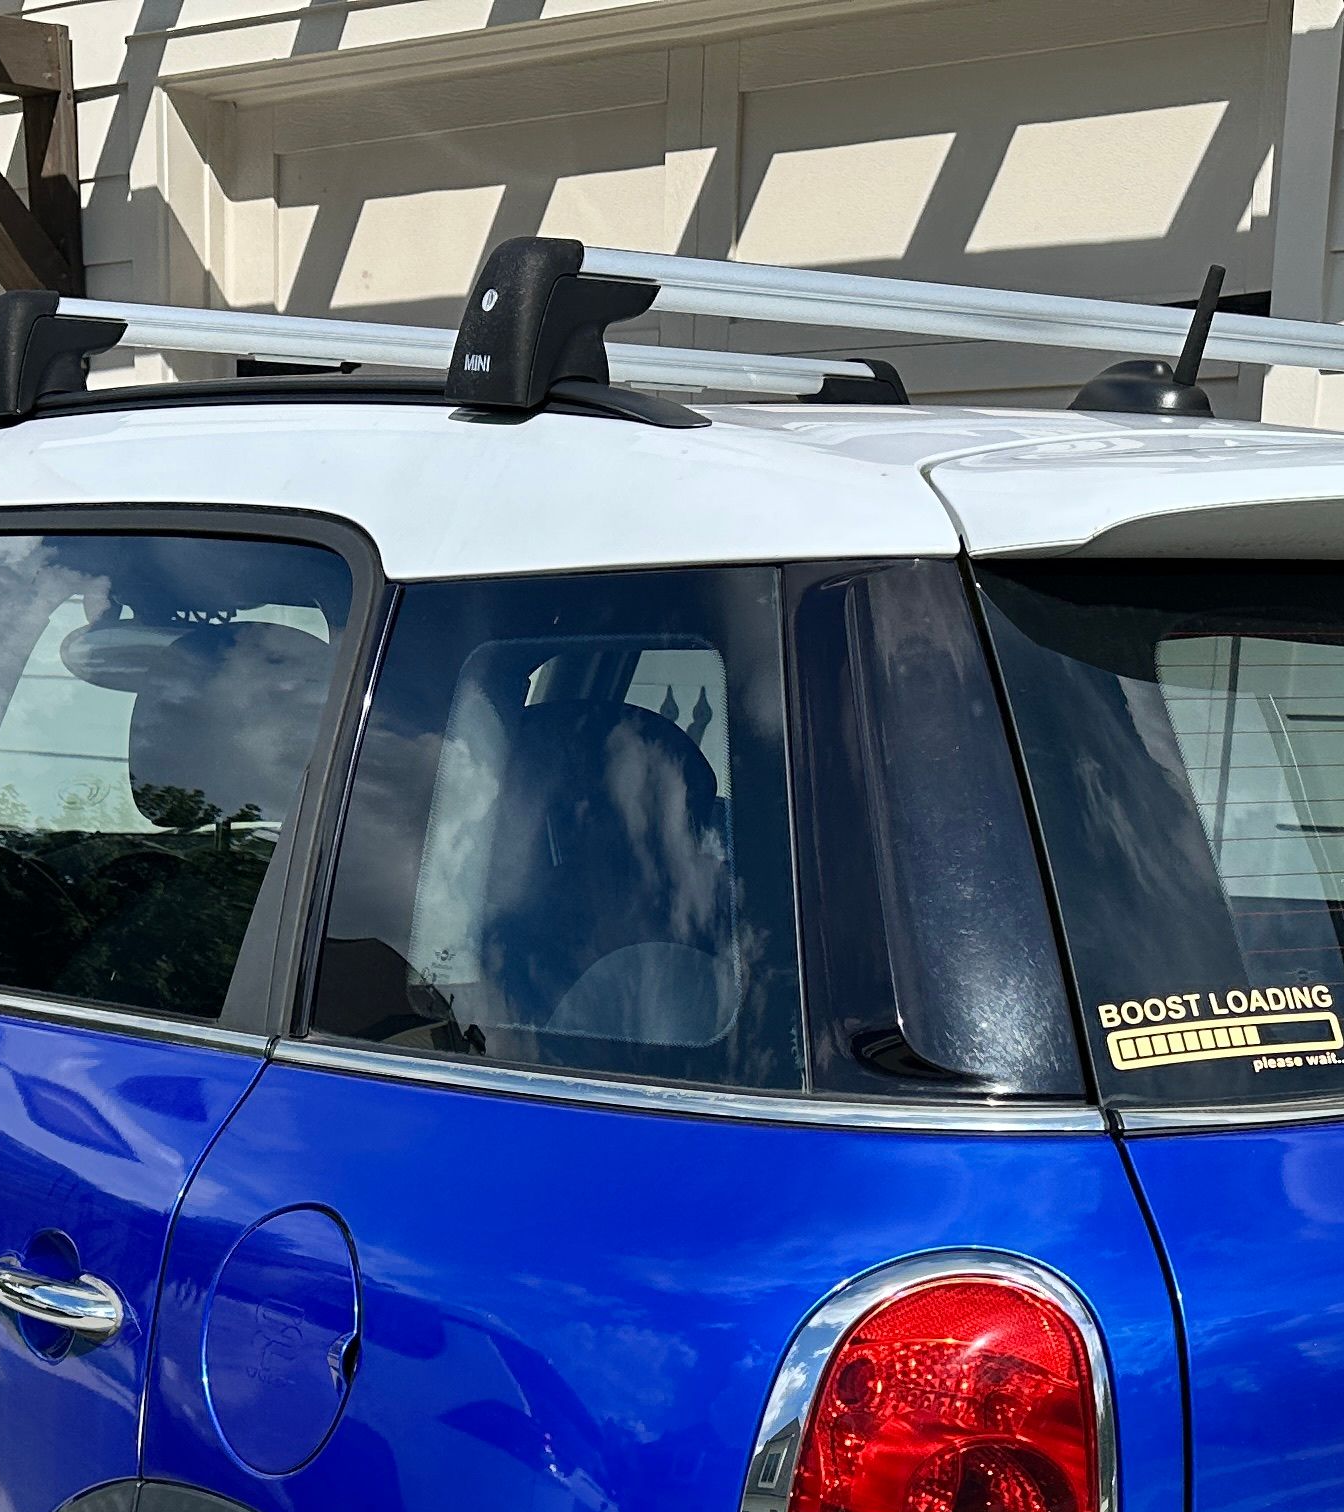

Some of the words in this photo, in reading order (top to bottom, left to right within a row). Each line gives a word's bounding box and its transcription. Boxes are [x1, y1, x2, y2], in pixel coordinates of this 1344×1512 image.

[463, 353, 491, 373] MINI
[1097, 993, 1201, 1029] BOOST
[1208, 984, 1334, 1016] LOADING
[1252, 1056, 1303, 1073] please
